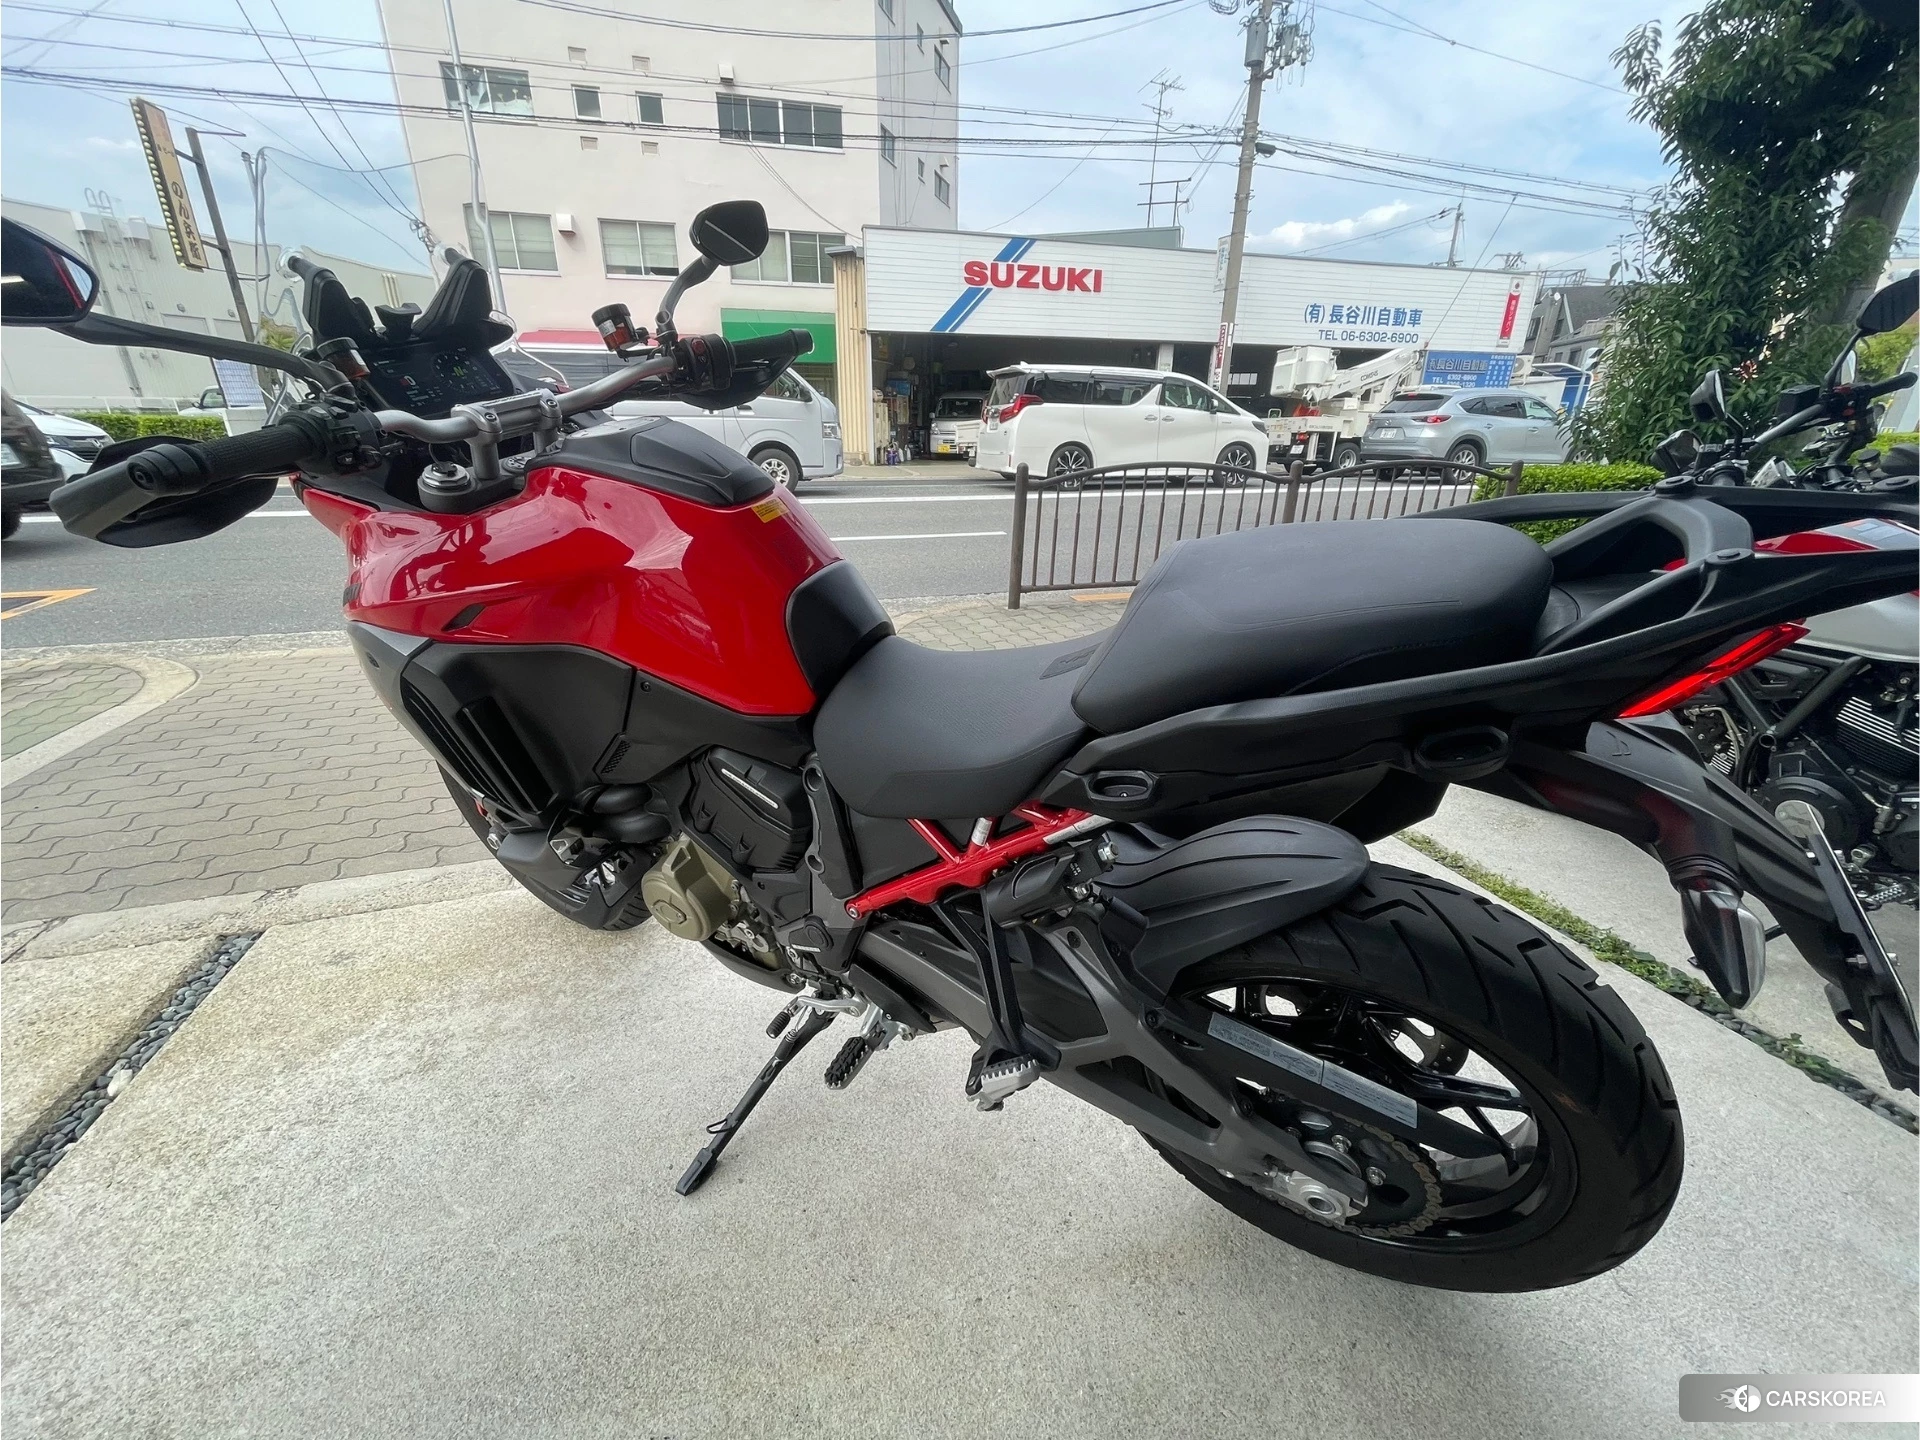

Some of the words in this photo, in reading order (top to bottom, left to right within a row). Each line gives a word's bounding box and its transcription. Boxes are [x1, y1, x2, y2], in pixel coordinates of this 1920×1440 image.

[964, 261, 1103, 293] SUZUKI
[1319, 329, 1338, 341] TEL
[1341, 330, 1419, 344] 06-6302-6900
[1432, 376, 1444, 384] TEL
